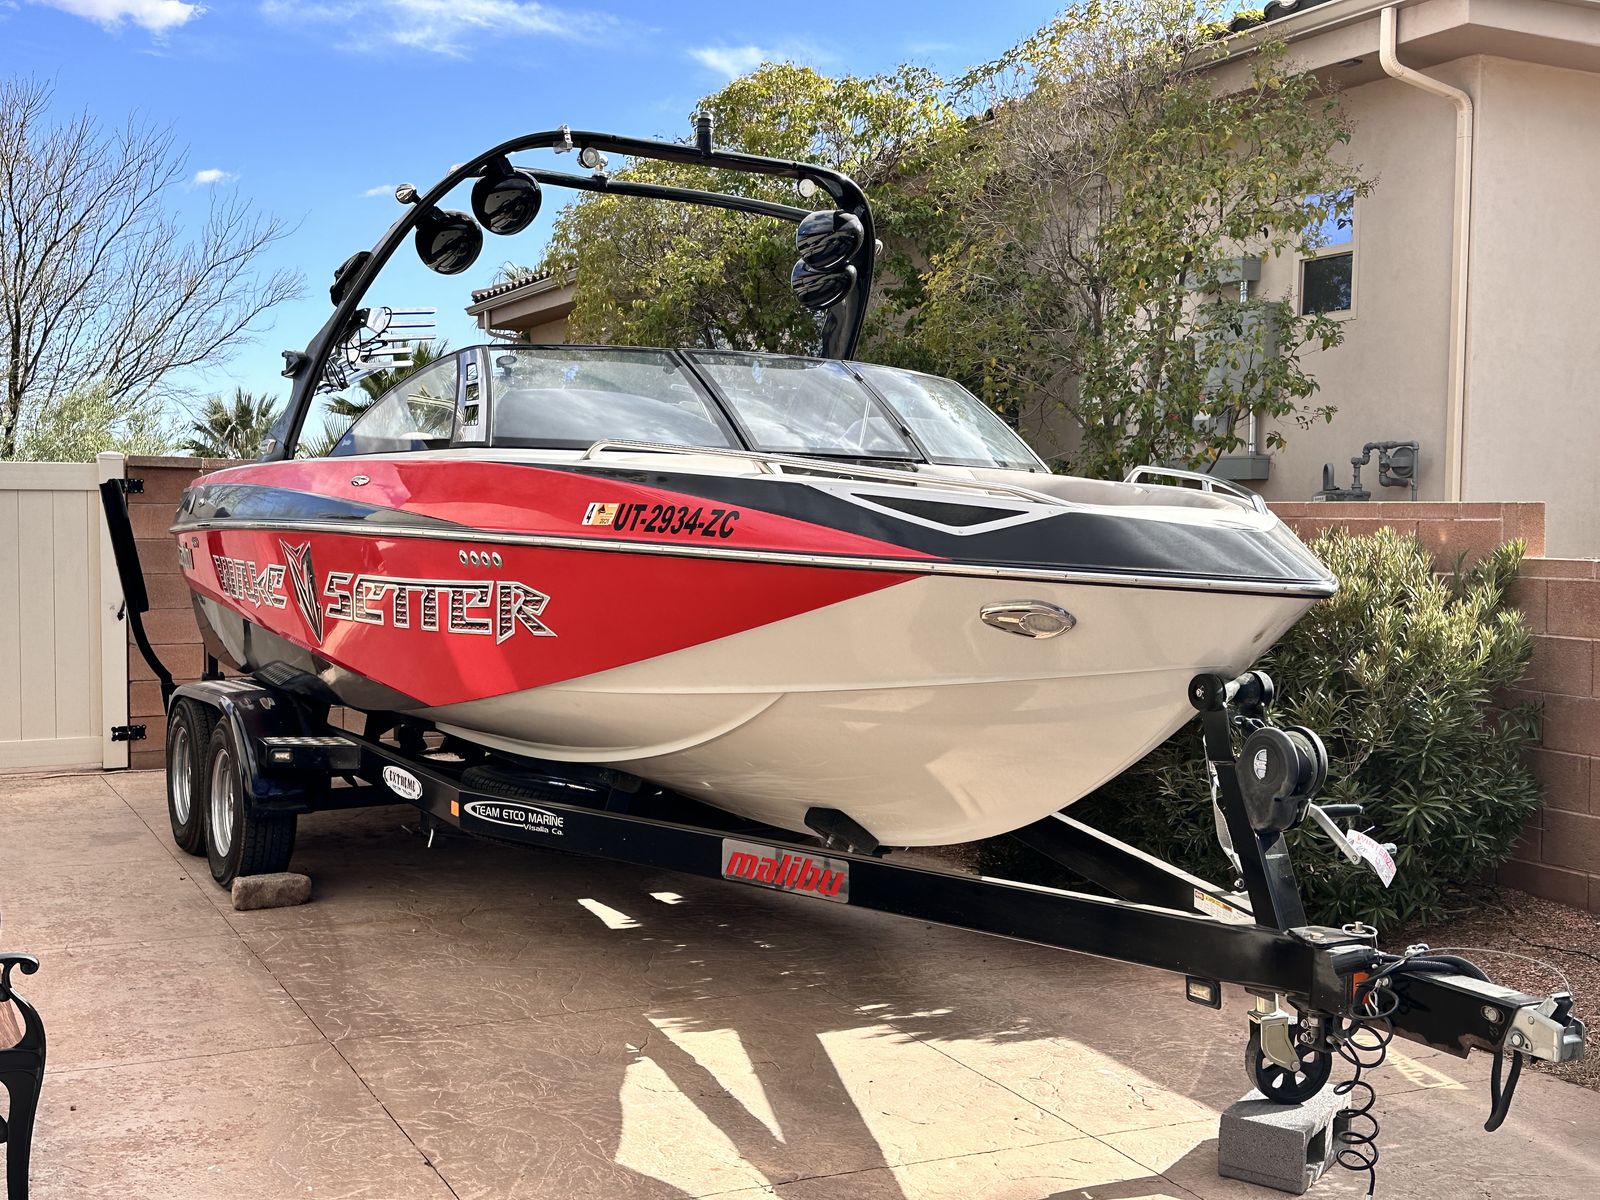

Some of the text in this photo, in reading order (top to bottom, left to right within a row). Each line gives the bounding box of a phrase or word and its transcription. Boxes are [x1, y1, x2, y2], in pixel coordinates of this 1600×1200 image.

[614, 503, 740, 539] UT-2934-ZC
[324, 571, 558, 646] SETTER
[389, 769, 416, 793] EXTREME
[475, 805, 564, 827] TEAM ETCO MARINE
[725, 851, 845, 897] malibu
